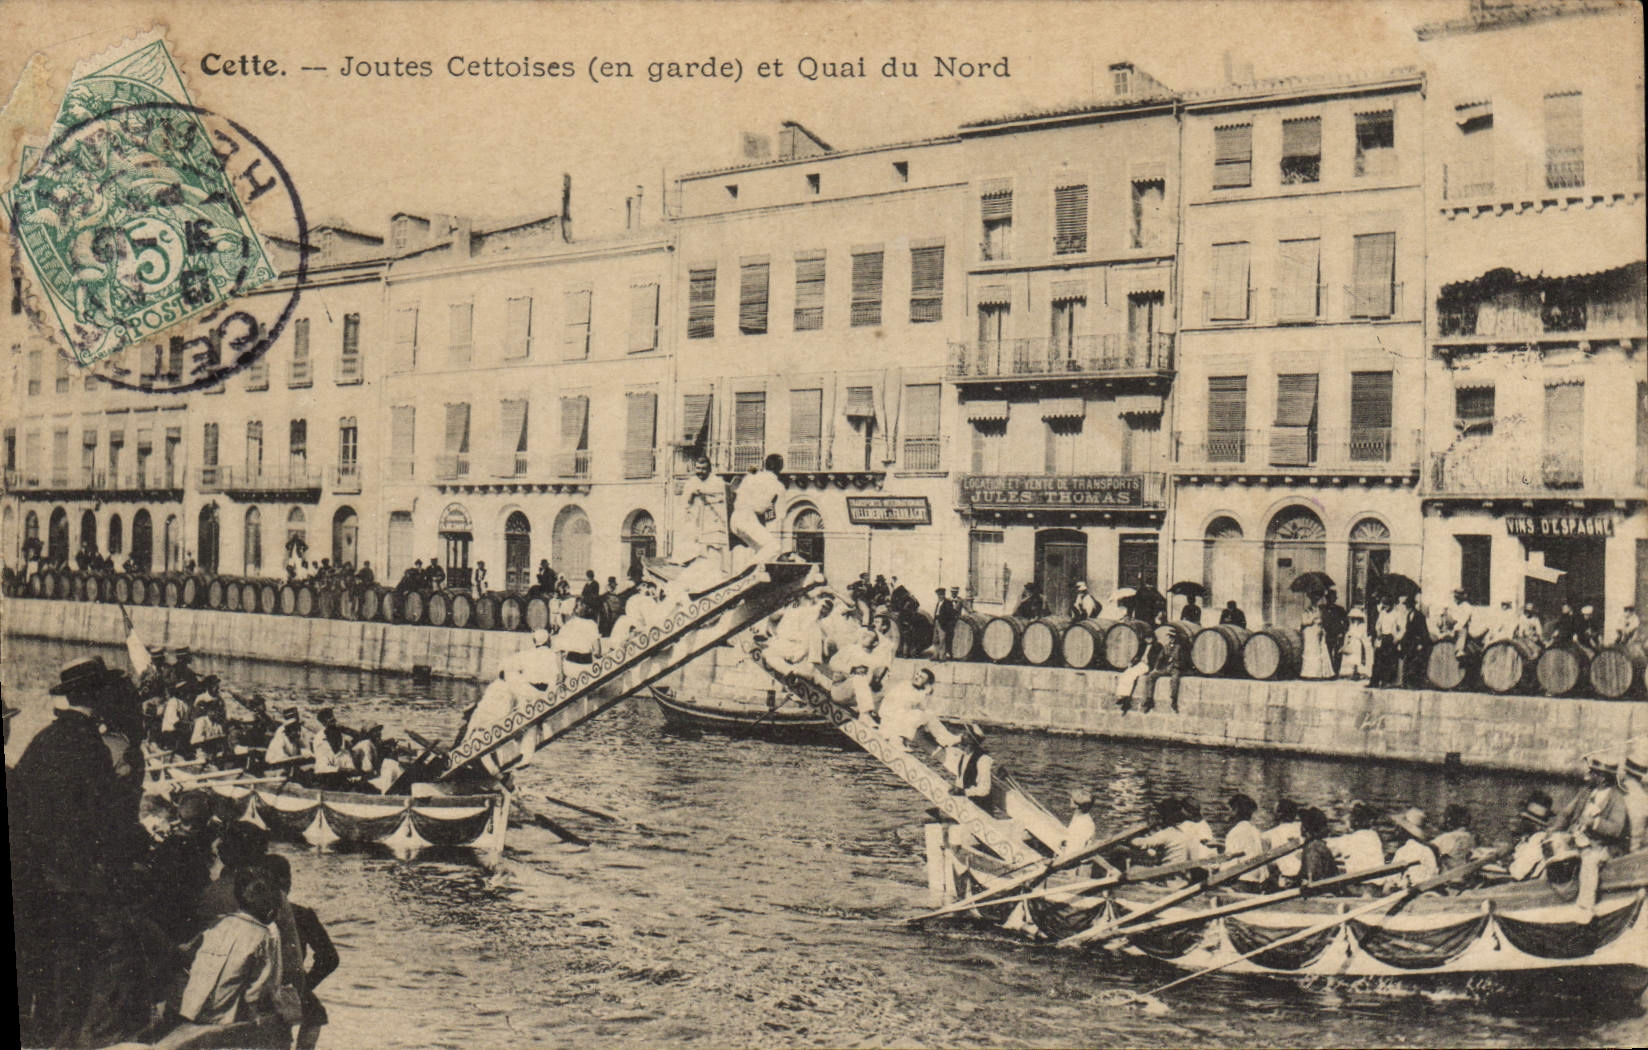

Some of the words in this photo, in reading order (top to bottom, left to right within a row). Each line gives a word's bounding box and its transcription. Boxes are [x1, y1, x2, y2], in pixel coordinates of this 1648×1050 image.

[963, 477, 1005, 490] LOCATION
[1007, 478, 1020, 490] ET
[1024, 478, 1055, 490] VENTE
[1056, 478, 1069, 490] DE
[1072, 478, 1140, 490] TRANSPORTS
[971, 491, 1033, 503] JULES
[1044, 491, 1131, 504] THOMAS
[1506, 518, 1535, 535] VINS
[1541, 518, 1613, 535] D'ESPAGNE
